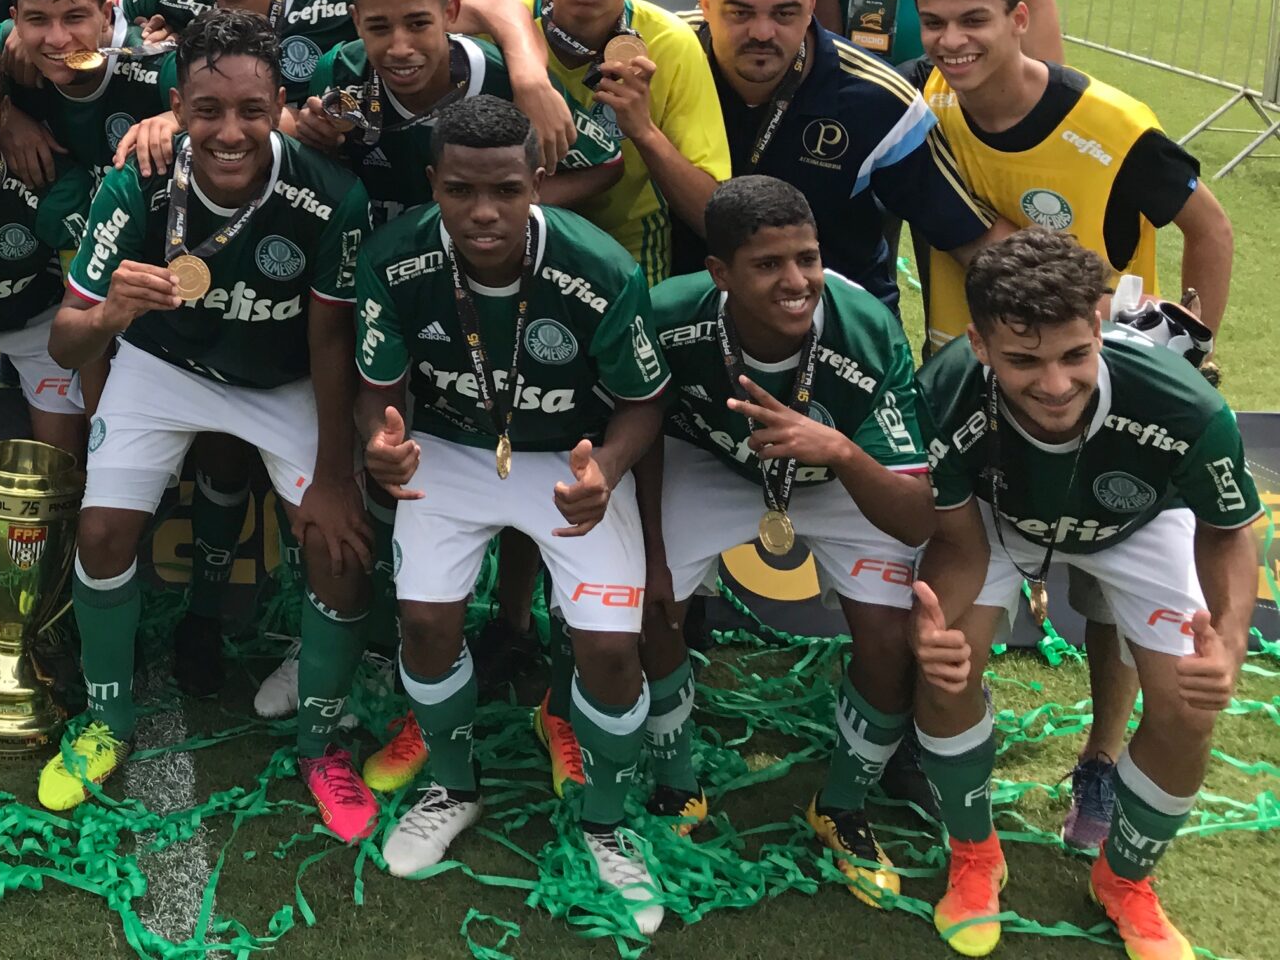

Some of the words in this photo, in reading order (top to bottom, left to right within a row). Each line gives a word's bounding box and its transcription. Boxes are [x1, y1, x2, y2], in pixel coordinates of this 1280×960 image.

[554, 26, 590, 54] PAULISTA
[113, 61, 158, 84] cefisa
[282, 54, 319, 77] PALMEIRAS
[761, 109, 783, 151] PAULISTA
[1061, 129, 1113, 167] crefisa
[274, 179, 332, 221] crefisa
[226, 205, 255, 237] PAULISTA
[1023, 204, 1072, 230] PALMEIRAS
[86, 207, 130, 281] crefisa
[261, 253, 303, 277] PALMEIRAS
[542, 266, 609, 314] crefisa
[361, 298, 383, 366] crefia
[418, 331, 451, 342] adidas
[512, 318, 523, 367] PAULISTA
[528, 337, 573, 362] PALMEIRAS
[805, 336, 818, 386] PAULISTA
[471, 349, 490, 400] PAULISTA
[1104, 414, 1190, 456] crefisa
[20, 501, 41, 516] 75
[1099, 488, 1153, 511] PALMEIRAS
[14, 529, 41, 540] FPF
[1003, 514, 1120, 543] refis
